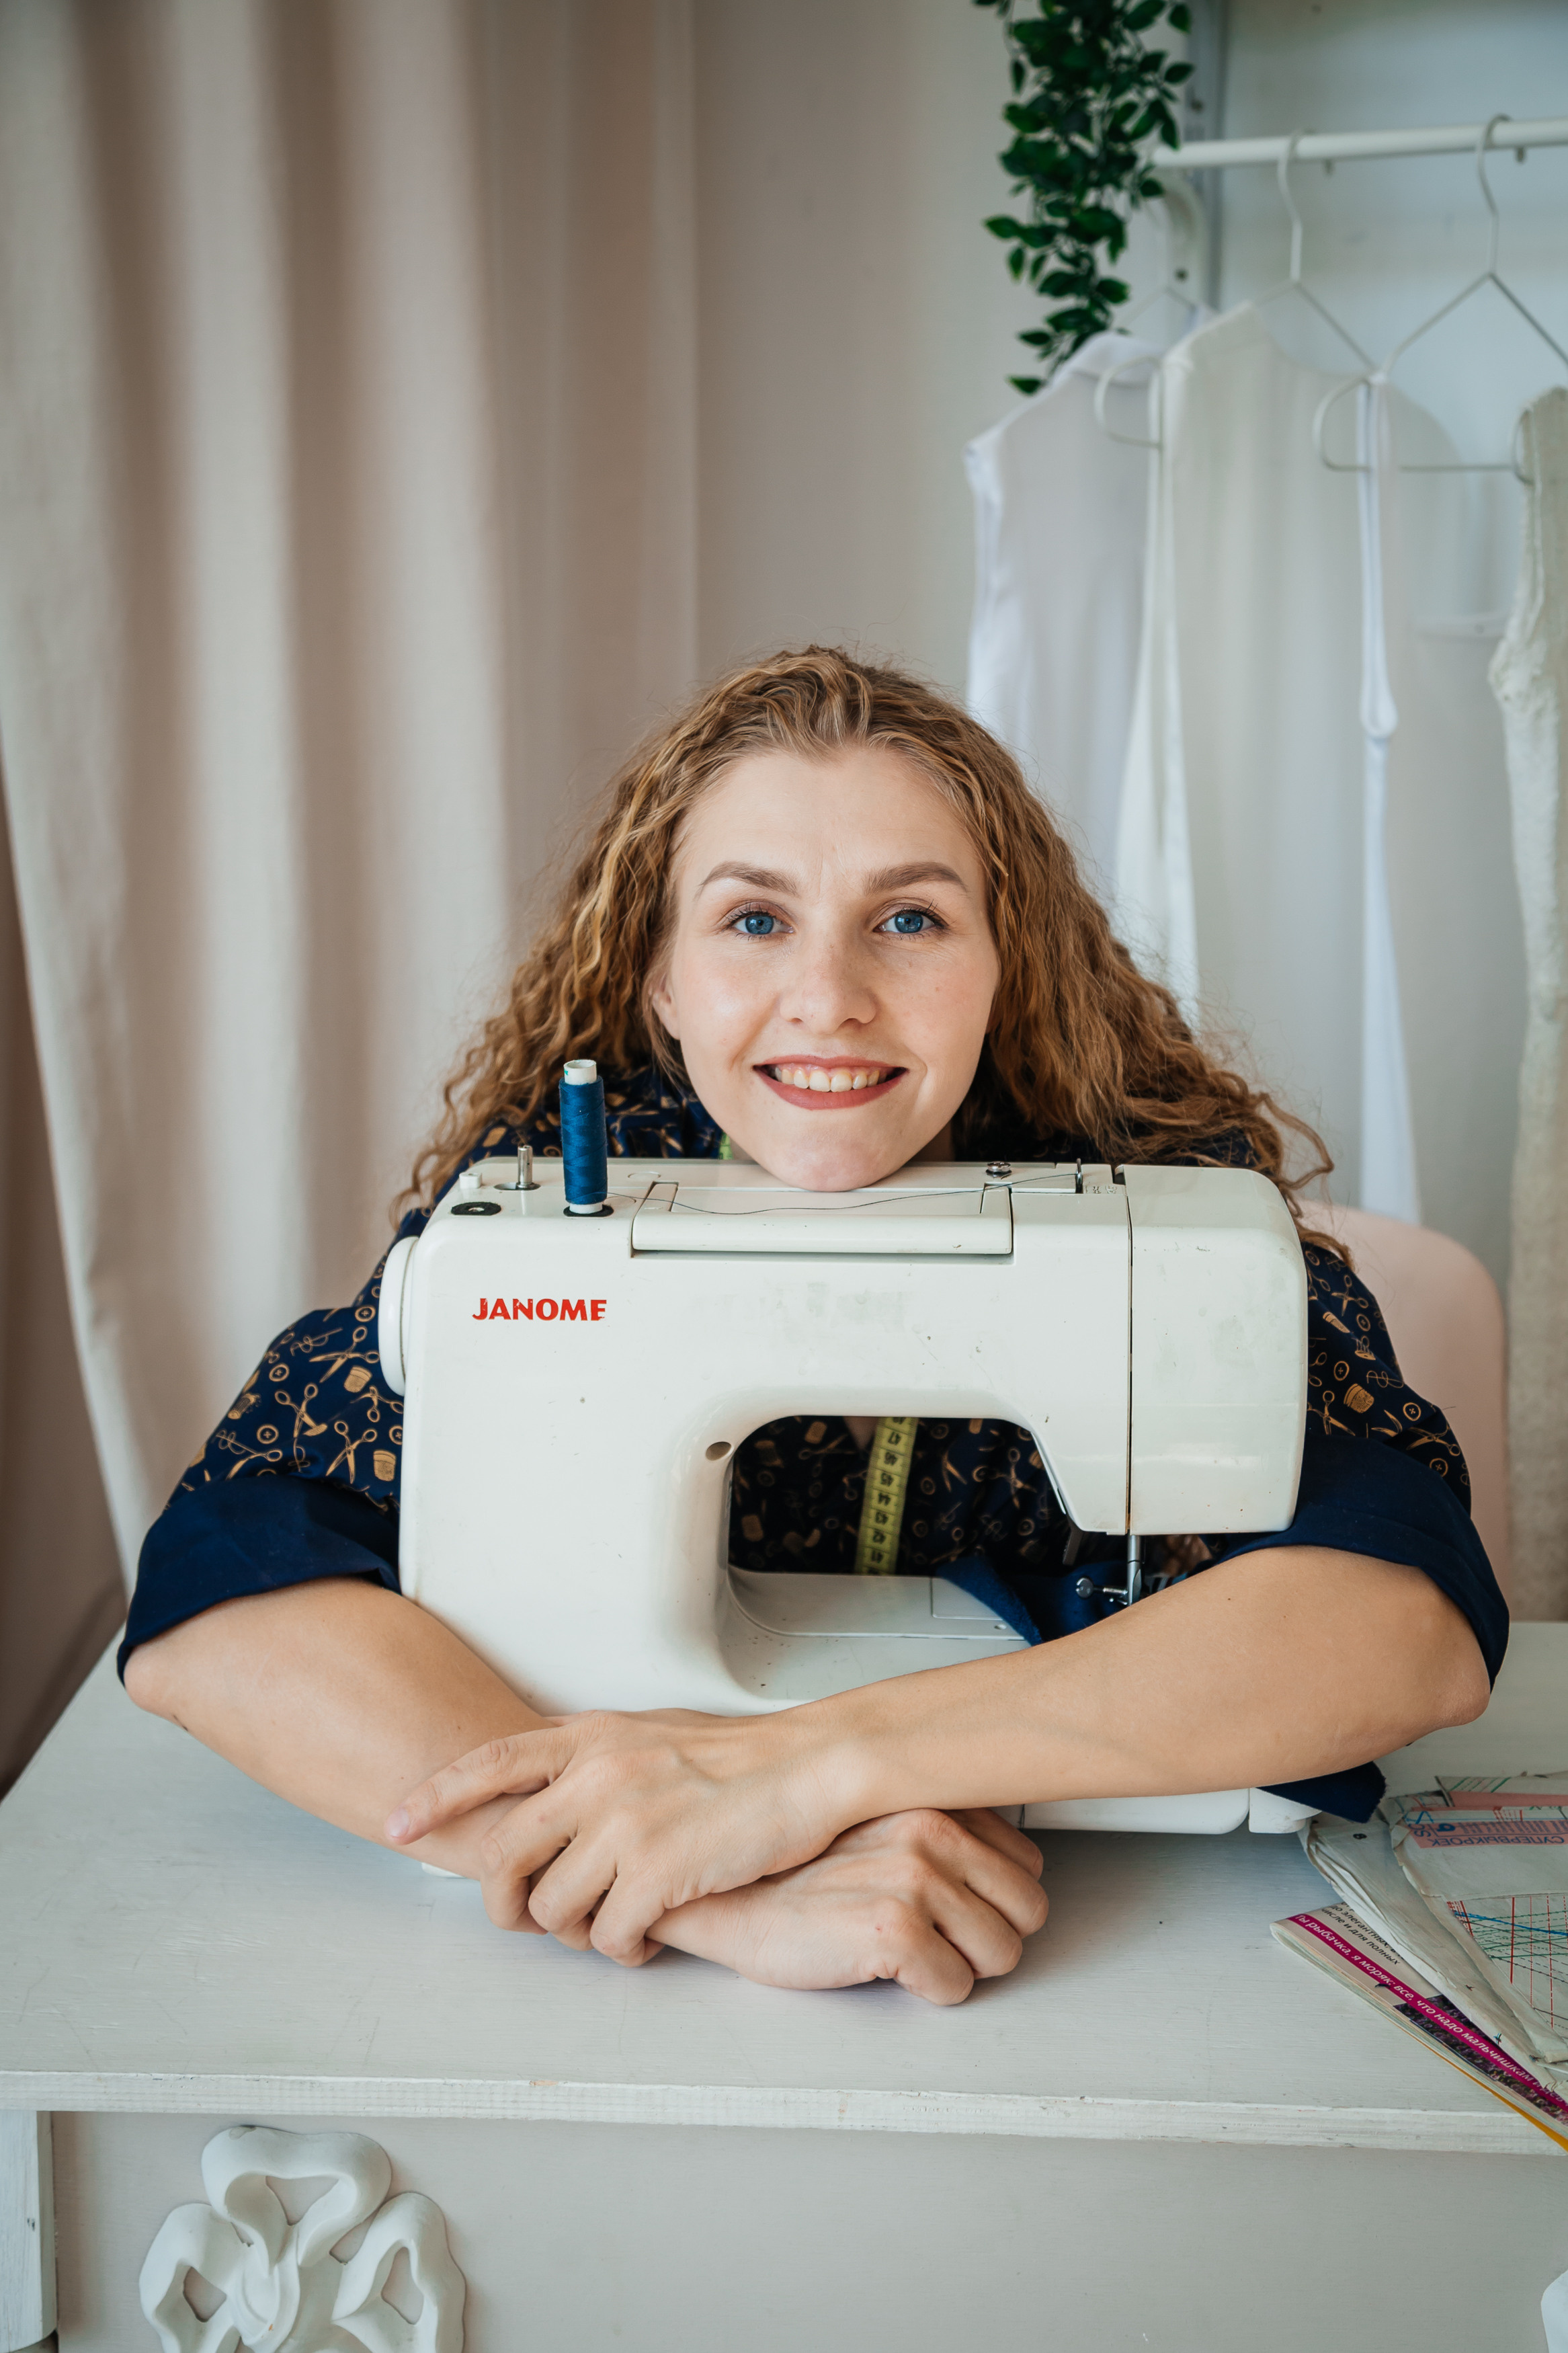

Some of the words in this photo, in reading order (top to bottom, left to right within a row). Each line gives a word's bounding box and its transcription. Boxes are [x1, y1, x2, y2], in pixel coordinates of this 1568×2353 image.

[472, 1298, 606, 1320] JANOME
[887, 1431, 901, 1445] 47
[878, 1492, 891, 1506] 44
[1428, 1836, 1565, 1847] СУПЕРВЫКРОЕК
[1348, 1929, 1368, 1941] для
[1366, 1941, 1400, 1964] полных
[1306, 1921, 1351, 1956] рыбачка,
[1394, 1985, 1414, 2001] все,
[1417, 2000, 1436, 2014] что
[1434, 2013, 1463, 2033] надо
[1461, 2033, 1534, 2081] мальчишкам
